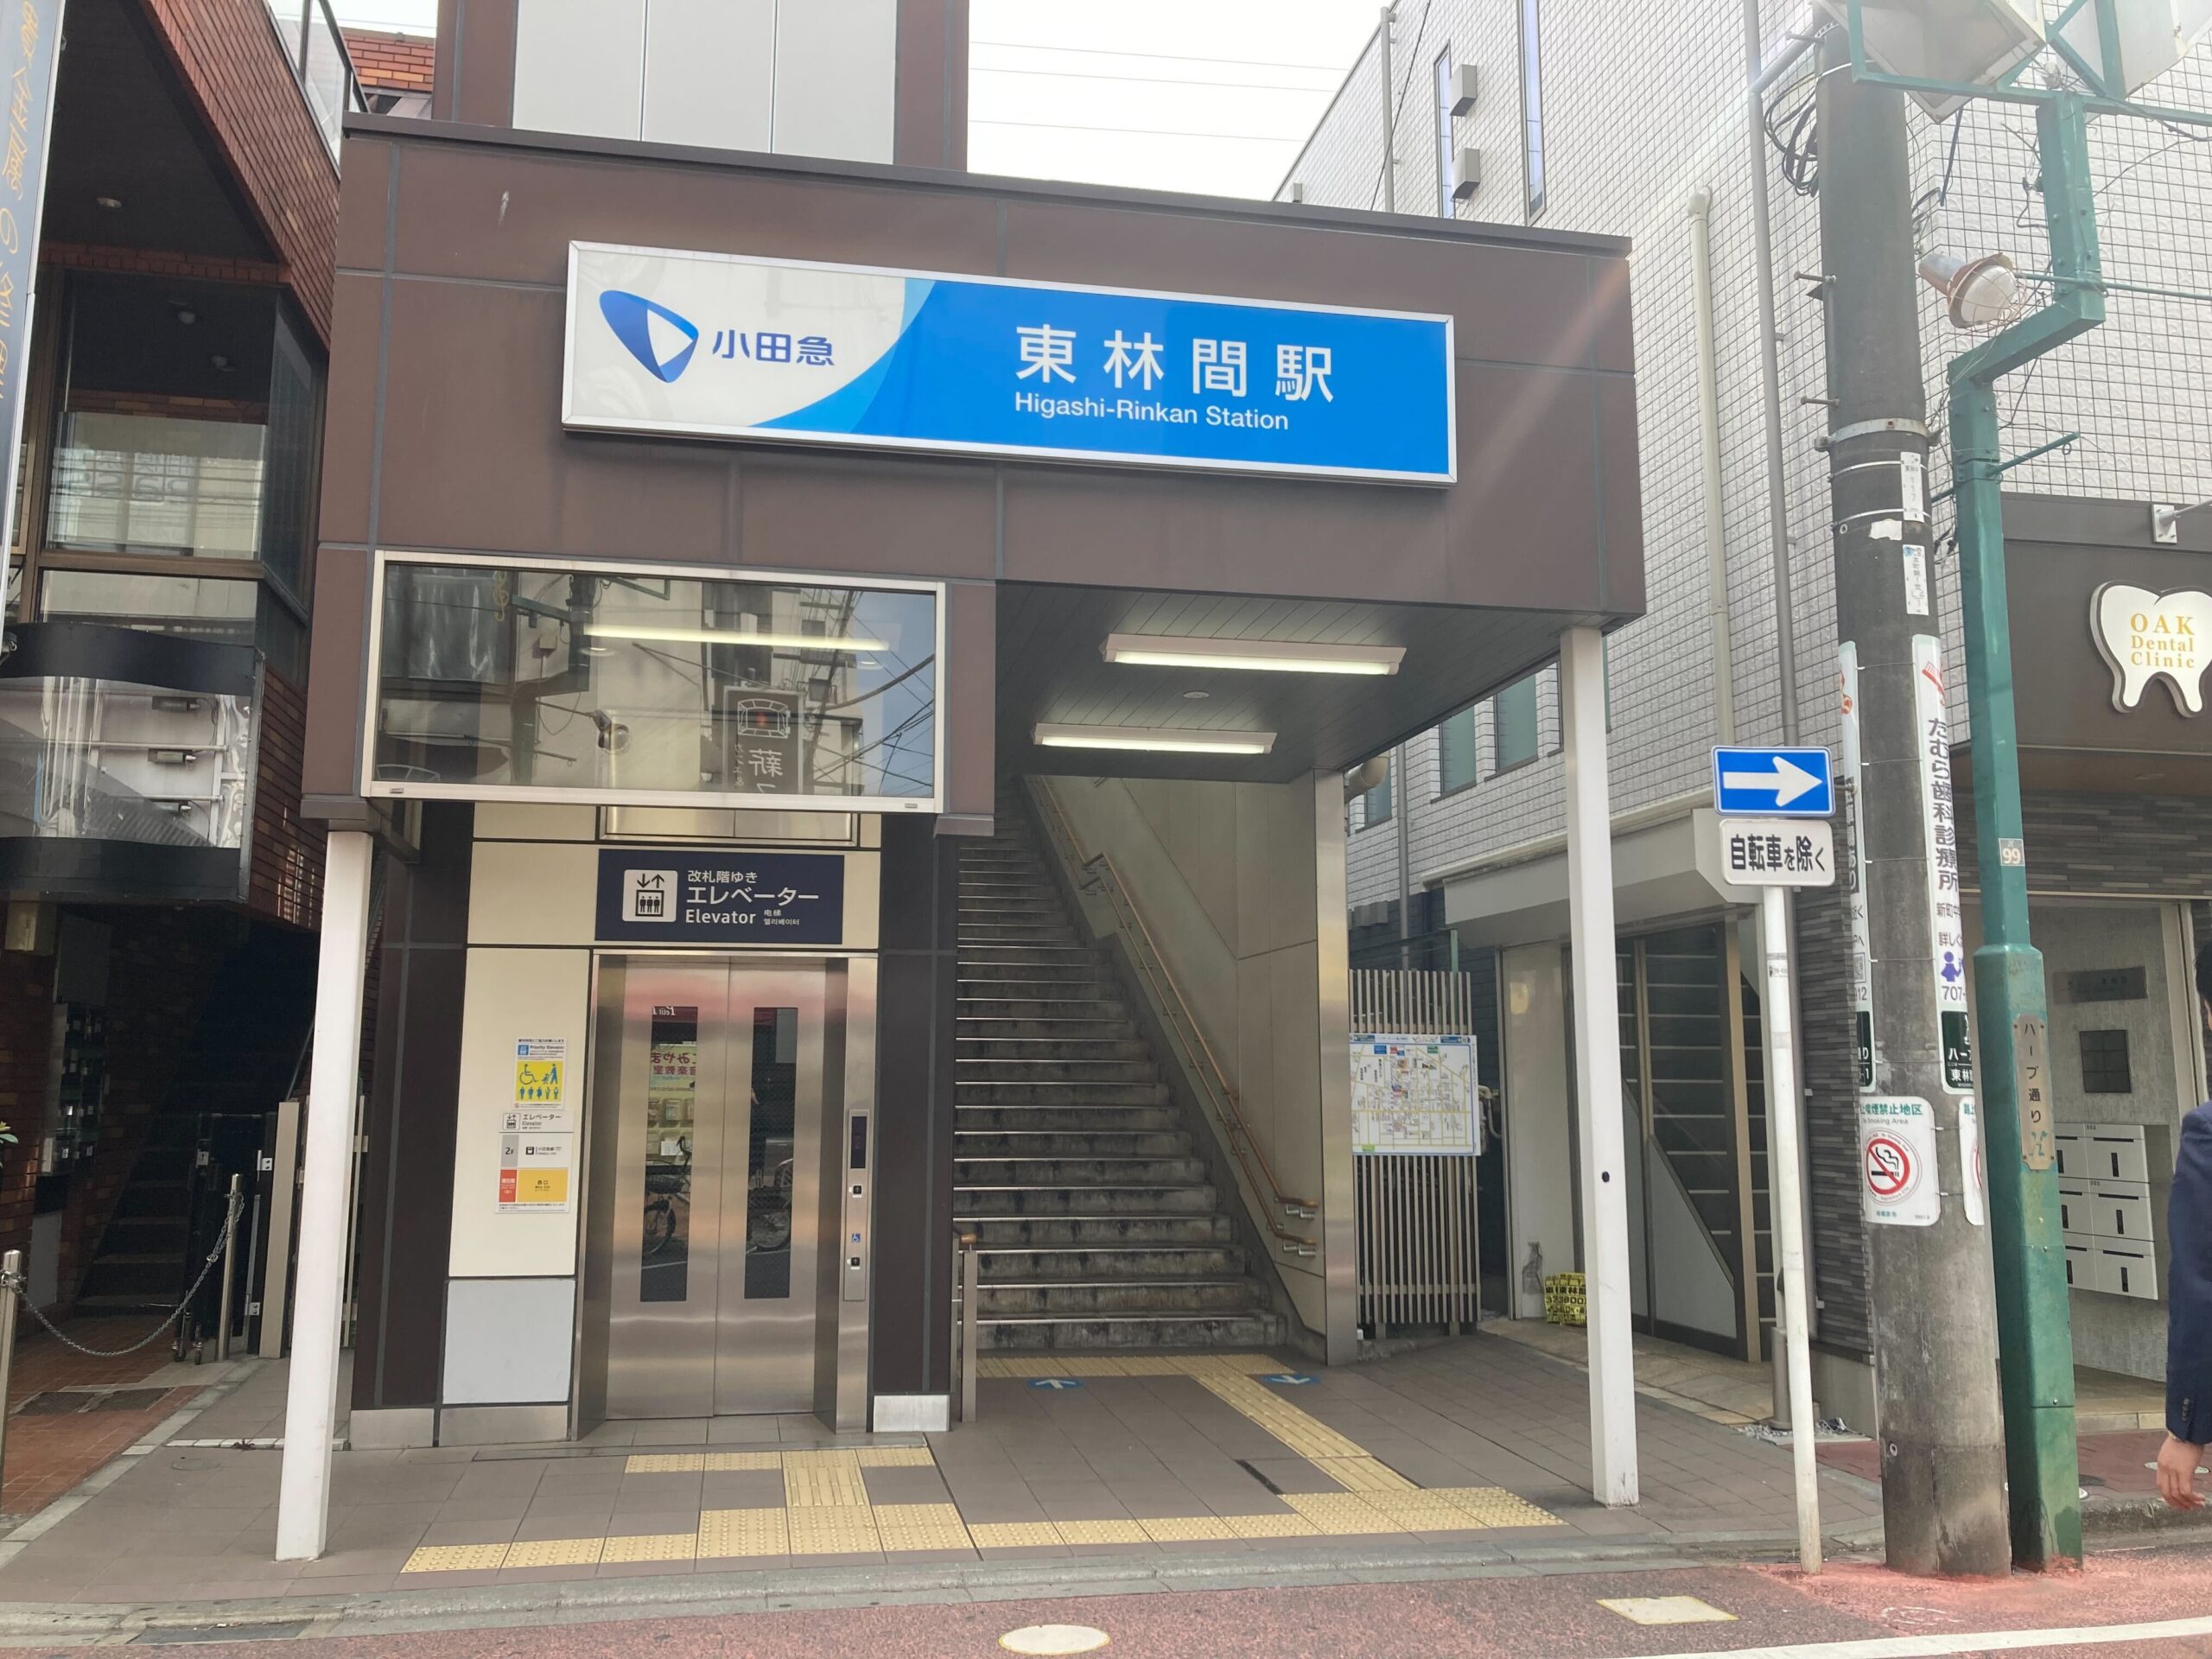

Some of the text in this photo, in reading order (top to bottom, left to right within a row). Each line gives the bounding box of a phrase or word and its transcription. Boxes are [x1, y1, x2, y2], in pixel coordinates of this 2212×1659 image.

[712, 329, 835, 365] 小田急
[1015, 323, 1334, 403] 東林間駅
[1015, 391, 1289, 430] Higashi-Rinkan Station
[2130, 613, 2195, 635] OAK
[2130, 635, 2195, 652] Dental
[2131, 651, 2195, 669] Clinic
[1928, 717, 1958, 893] たむら歯科診療所
[1731, 834, 1825, 872] 自転車を除く
[2002, 848, 2021, 864] 99
[688, 870, 758, 884] 改札階ゆき
[686, 886, 819, 906] エレベーター
[685, 909, 757, 925] Elevator
[2024, 1023, 2041, 1123] ハーブ通り
